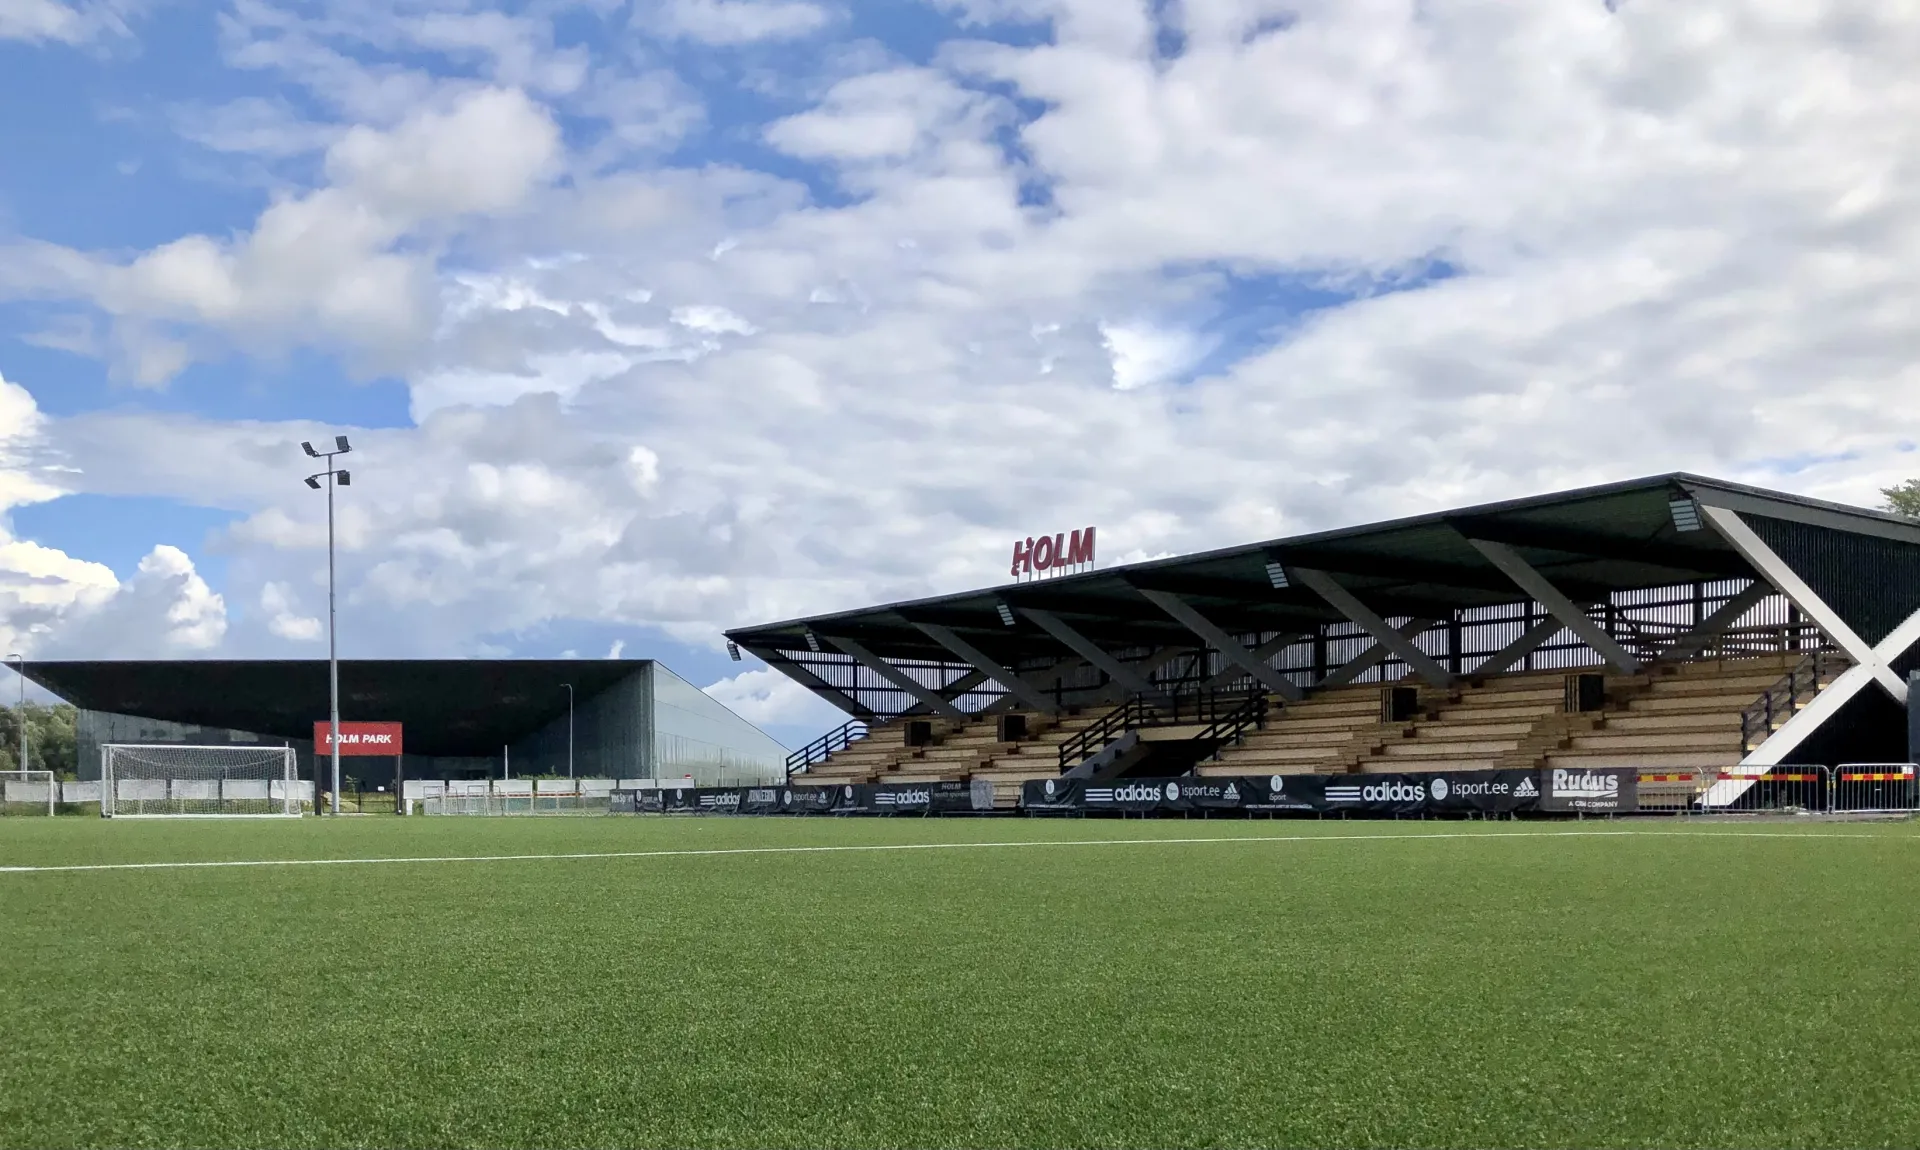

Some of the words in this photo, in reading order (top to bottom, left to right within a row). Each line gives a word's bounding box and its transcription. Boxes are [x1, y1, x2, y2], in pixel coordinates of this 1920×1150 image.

[1011, 527, 1096, 576] HOLM
[362, 734, 392, 744] PARK
[1553, 769, 1619, 790] Rudus
[896, 789, 930, 804] adidas
[1115, 784, 1161, 801] adidas
[1181, 784, 1220, 799] isport.ee
[1363, 781, 1426, 802] adidas
[1452, 781, 1509, 798] isport.ee
